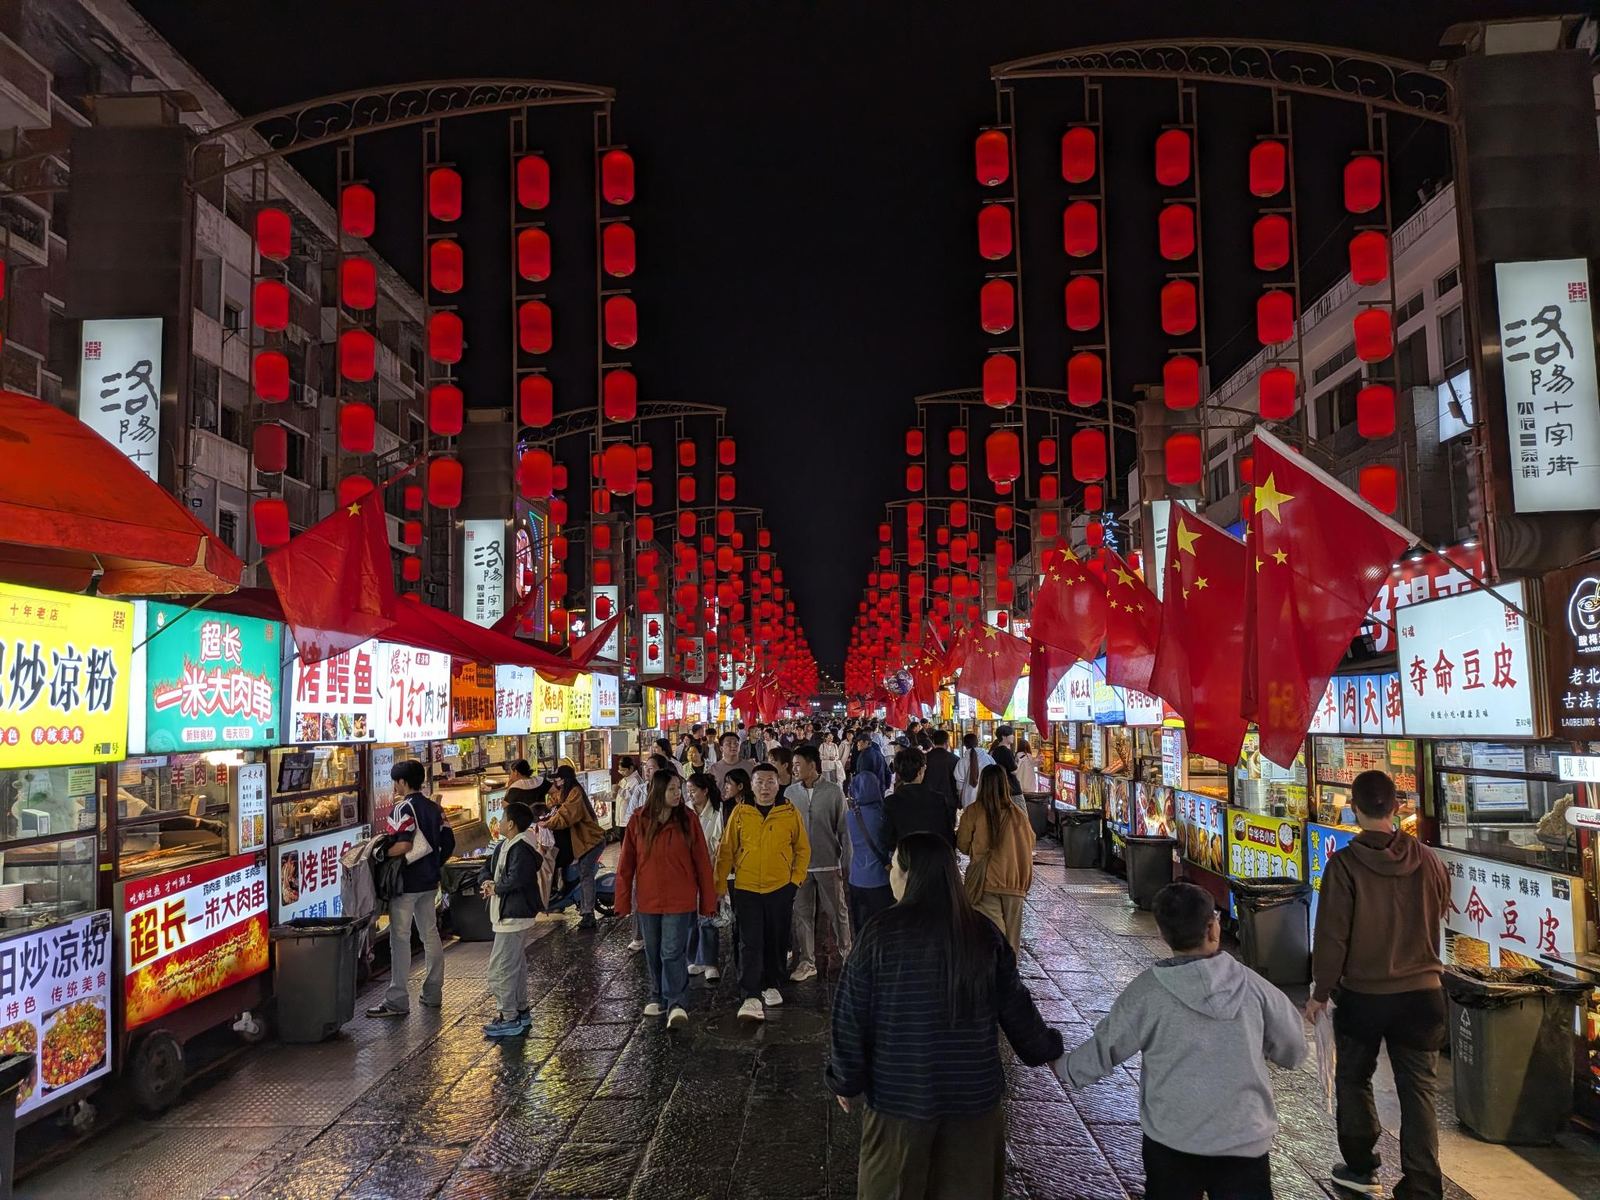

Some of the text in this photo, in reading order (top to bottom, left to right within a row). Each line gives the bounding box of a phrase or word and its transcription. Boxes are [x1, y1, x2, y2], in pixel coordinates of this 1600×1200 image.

[99, 359, 159, 477] 洛陽十
[201, 623, 242, 664] 超长
[1578, 632, 1600, 647] 酸梅
[0, 641, 118, 712] 炒凉粉
[1409, 642, 1518, 698] 夺命豆皮
[155, 669, 273, 725] 一米大肉串
[1561, 691, 1600, 709] 古法
[93, 742, 119, 755] 西号
[1468, 866, 1487, 885] 微辣
[1491, 872, 1512, 891] 中辣
[1519, 876, 1541, 898] 爆辣
[130, 879, 266, 967] 超长 一米大肉串
[51, 971, 107, 1005] 传统美食
